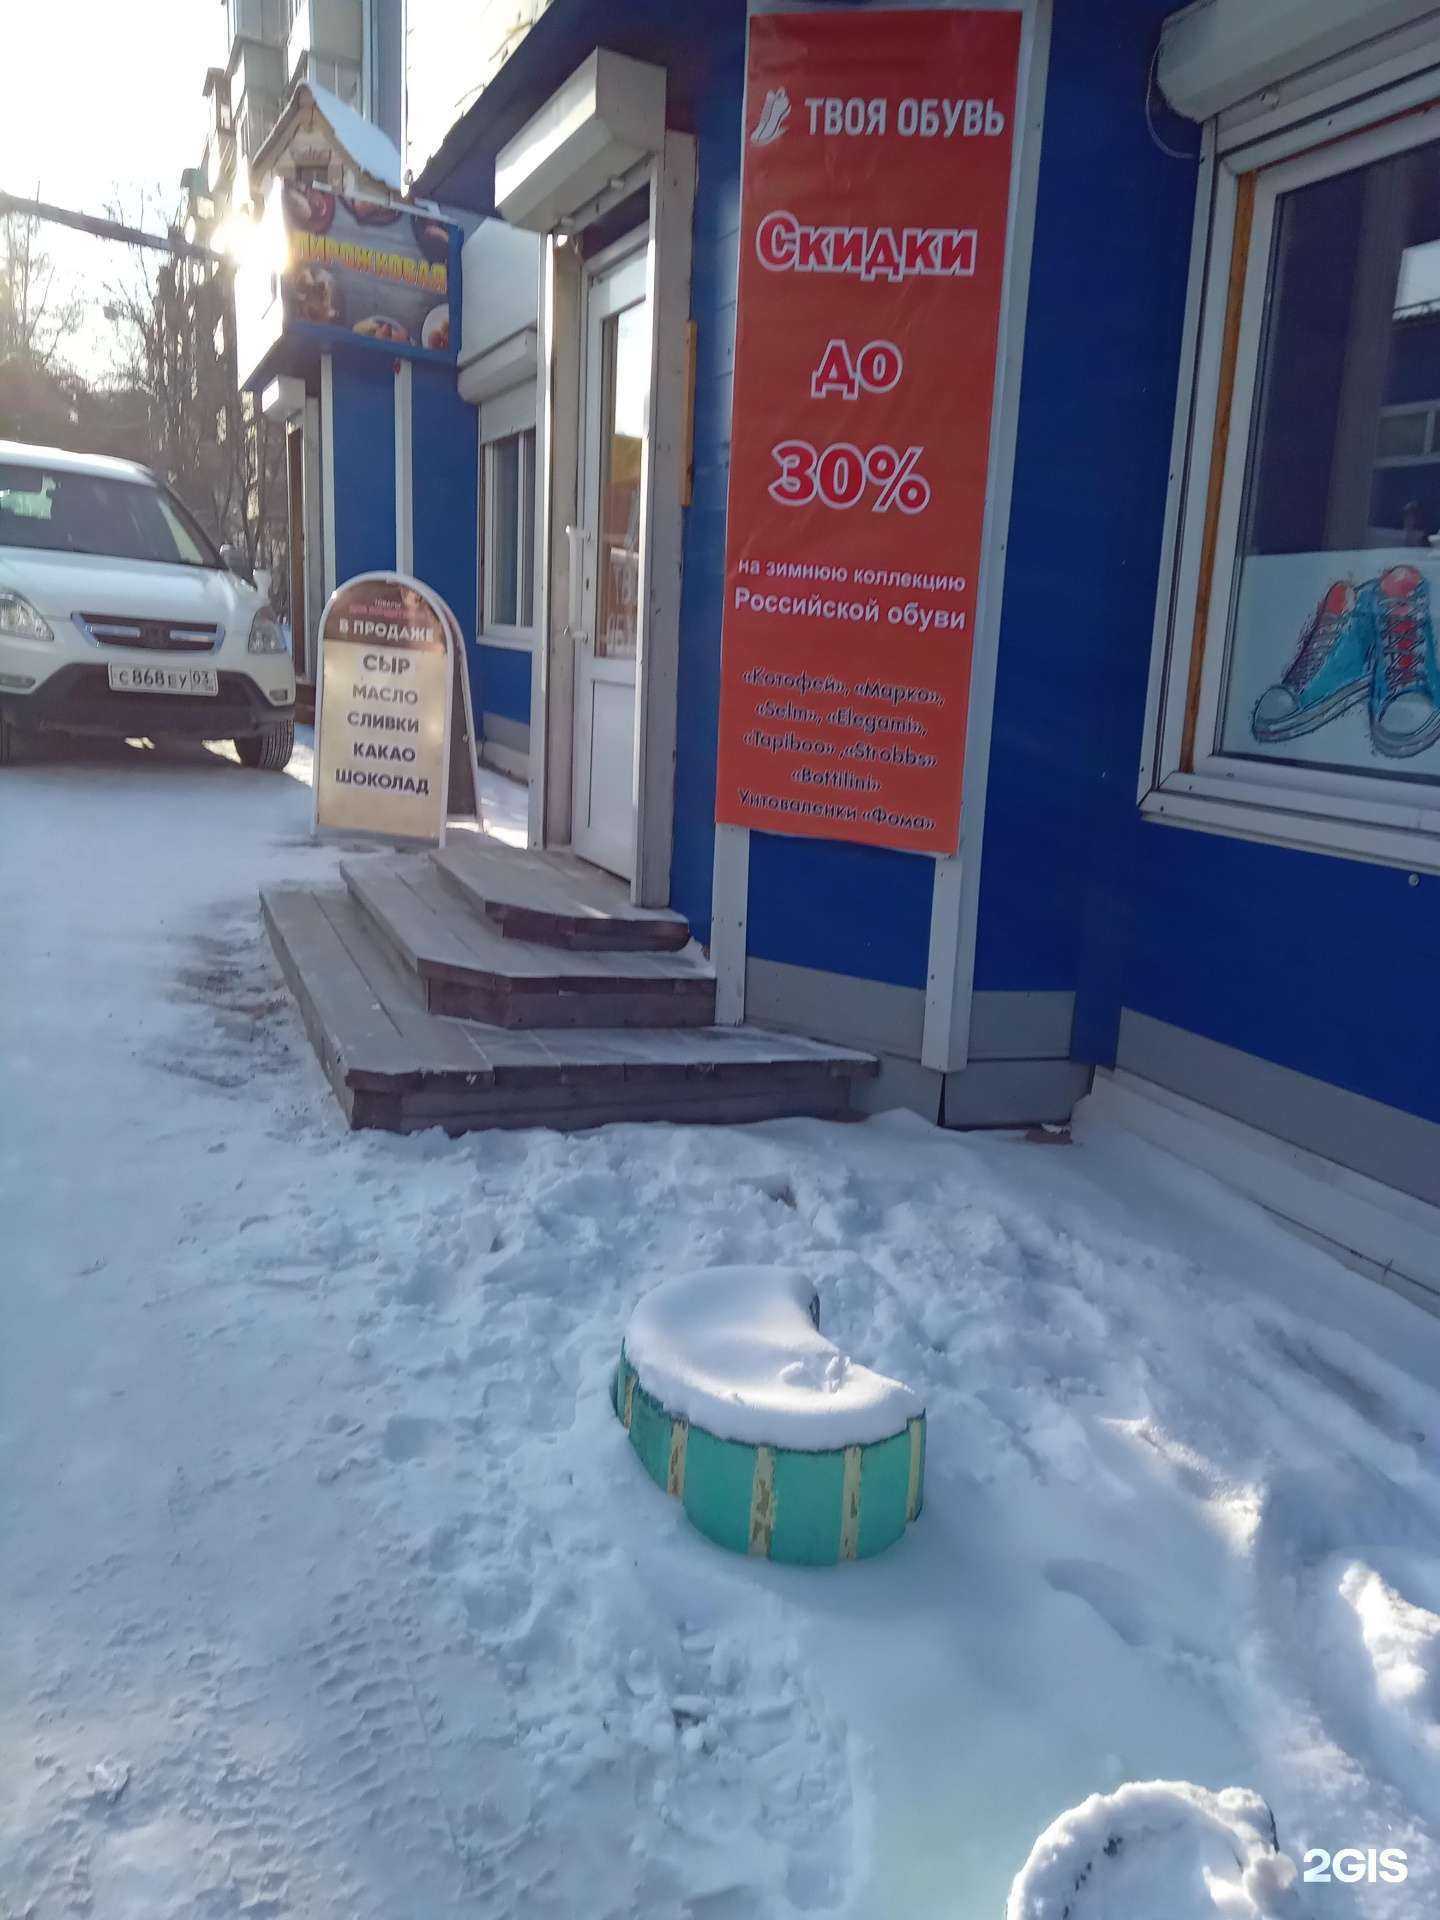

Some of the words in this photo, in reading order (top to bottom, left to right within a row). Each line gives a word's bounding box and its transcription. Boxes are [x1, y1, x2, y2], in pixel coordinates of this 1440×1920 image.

[804, 97, 887, 136] ТВОЯ
[897, 98, 1005, 138] ОБУВЬ
[767, 439, 931, 515] 30%
[738, 558, 760, 576] на
[766, 561, 848, 583] зимнюю
[853, 568, 966, 594] коллекцию
[735, 586, 880, 623] Российской
[887, 601, 966, 632] обуви
[339, 618, 349, 633] В
[353, 619, 434, 643] ПРОДАЖЕ
[363, 654, 411, 674] СЫР
[352, 684, 418, 705] МАСЛО
[347, 711, 420, 734] СЛИВКИ
[353, 743, 416, 763] КАКАО
[335, 768, 430, 795] ШОКОЛАД
